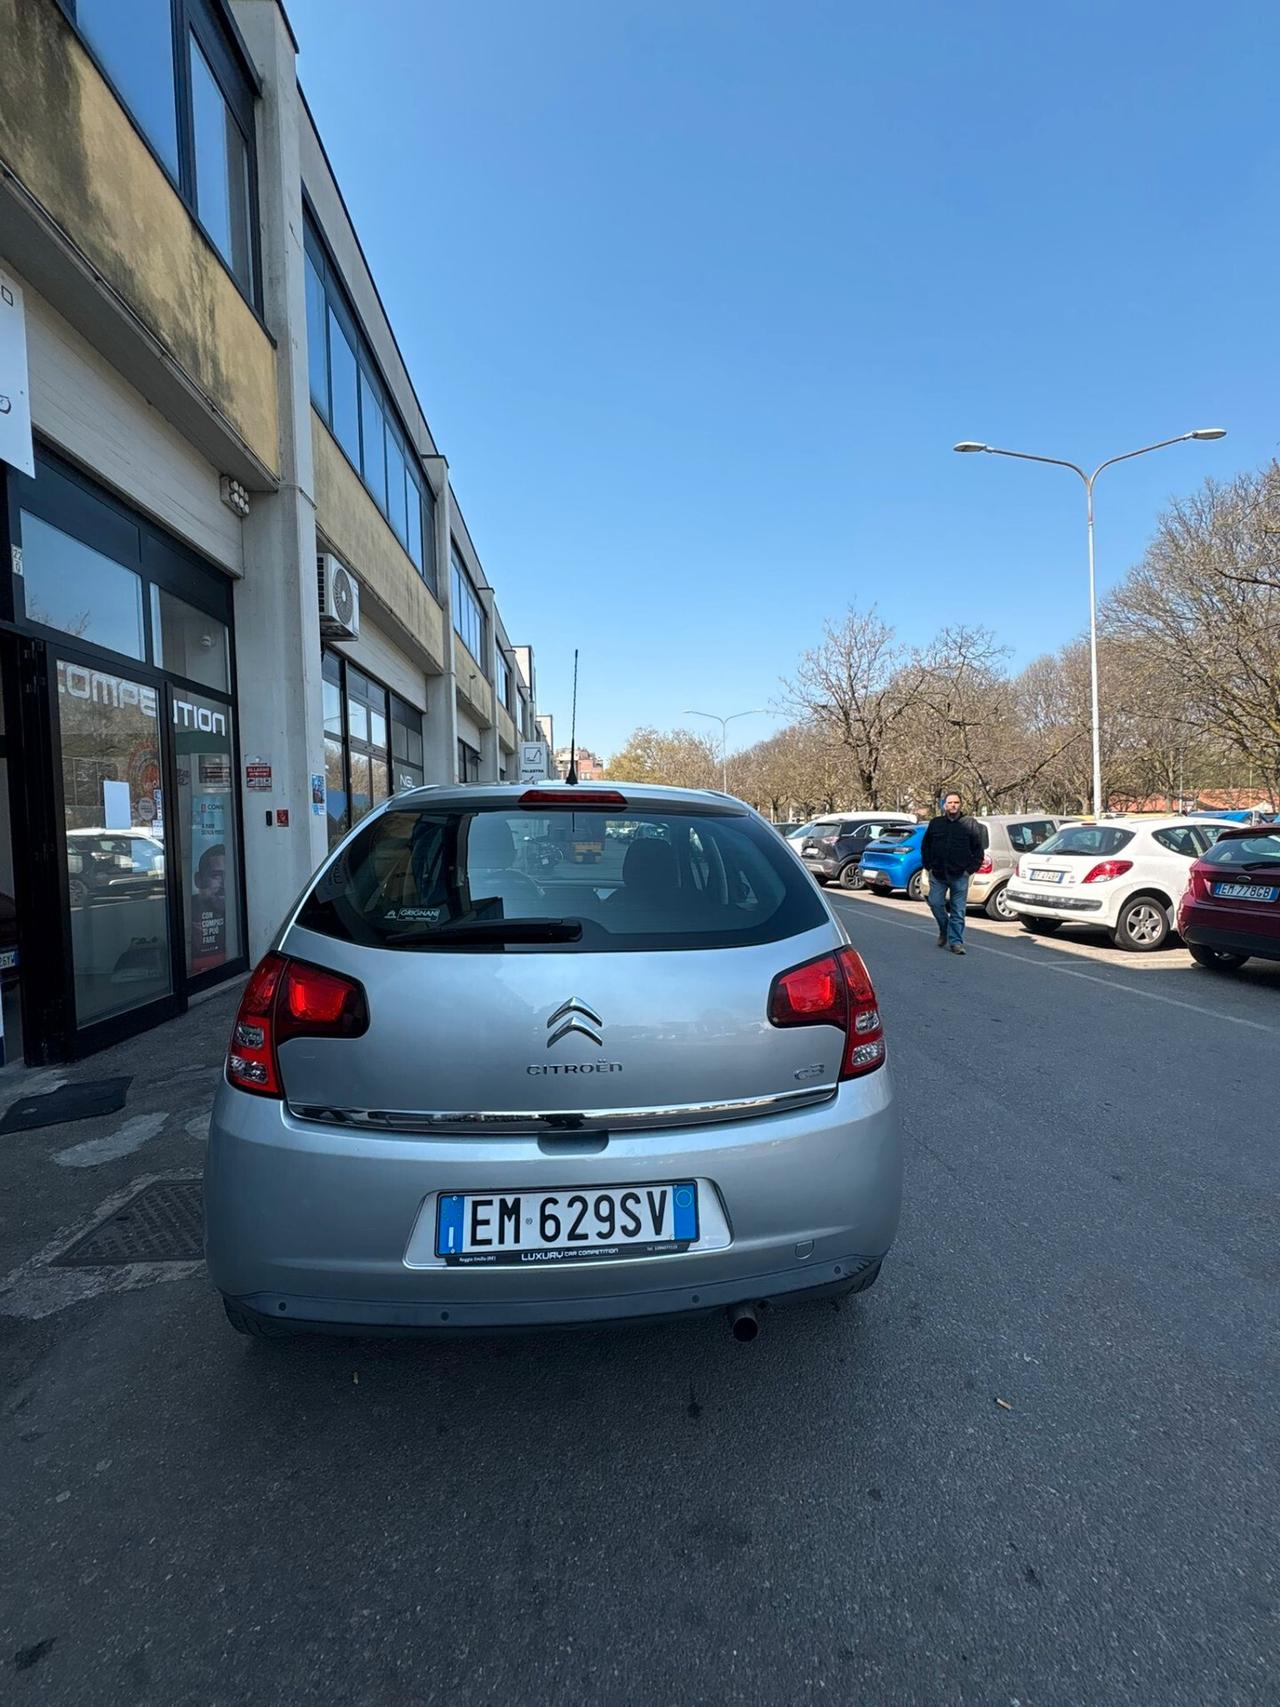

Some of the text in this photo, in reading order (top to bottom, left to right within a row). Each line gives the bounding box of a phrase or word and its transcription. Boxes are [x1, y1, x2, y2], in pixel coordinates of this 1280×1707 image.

[470, 1190, 668, 1246] EM 629SV
[521, 1251, 563, 1261] LUXURY
[578, 1247, 619, 1256] COMPETITION
